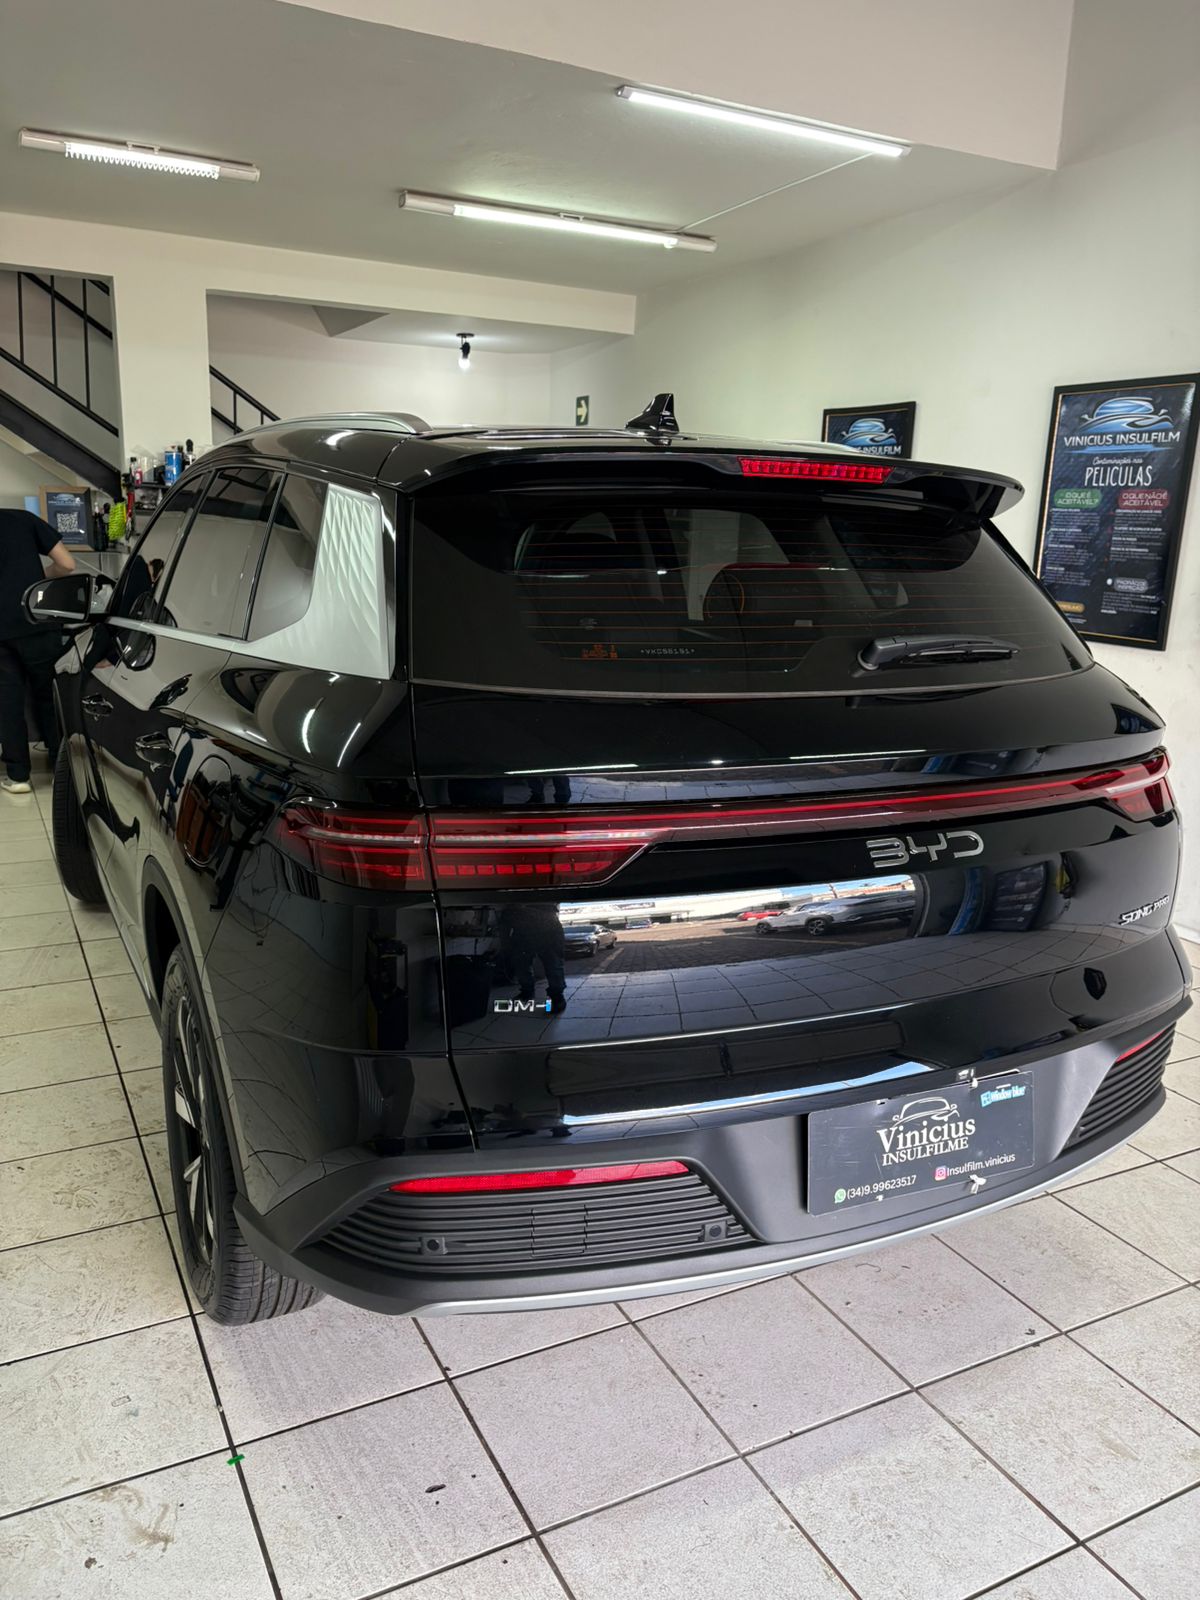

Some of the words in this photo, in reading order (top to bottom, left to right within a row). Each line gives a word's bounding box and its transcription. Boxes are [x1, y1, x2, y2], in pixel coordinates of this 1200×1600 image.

[1064, 434, 1113, 447] VINICIUS
[1116, 431, 1181, 444] INSULFILM
[1121, 904, 1153, 926] SONG
[877, 1118, 976, 1152] Vinicius
[882, 1136, 969, 1167] INSULFILME
